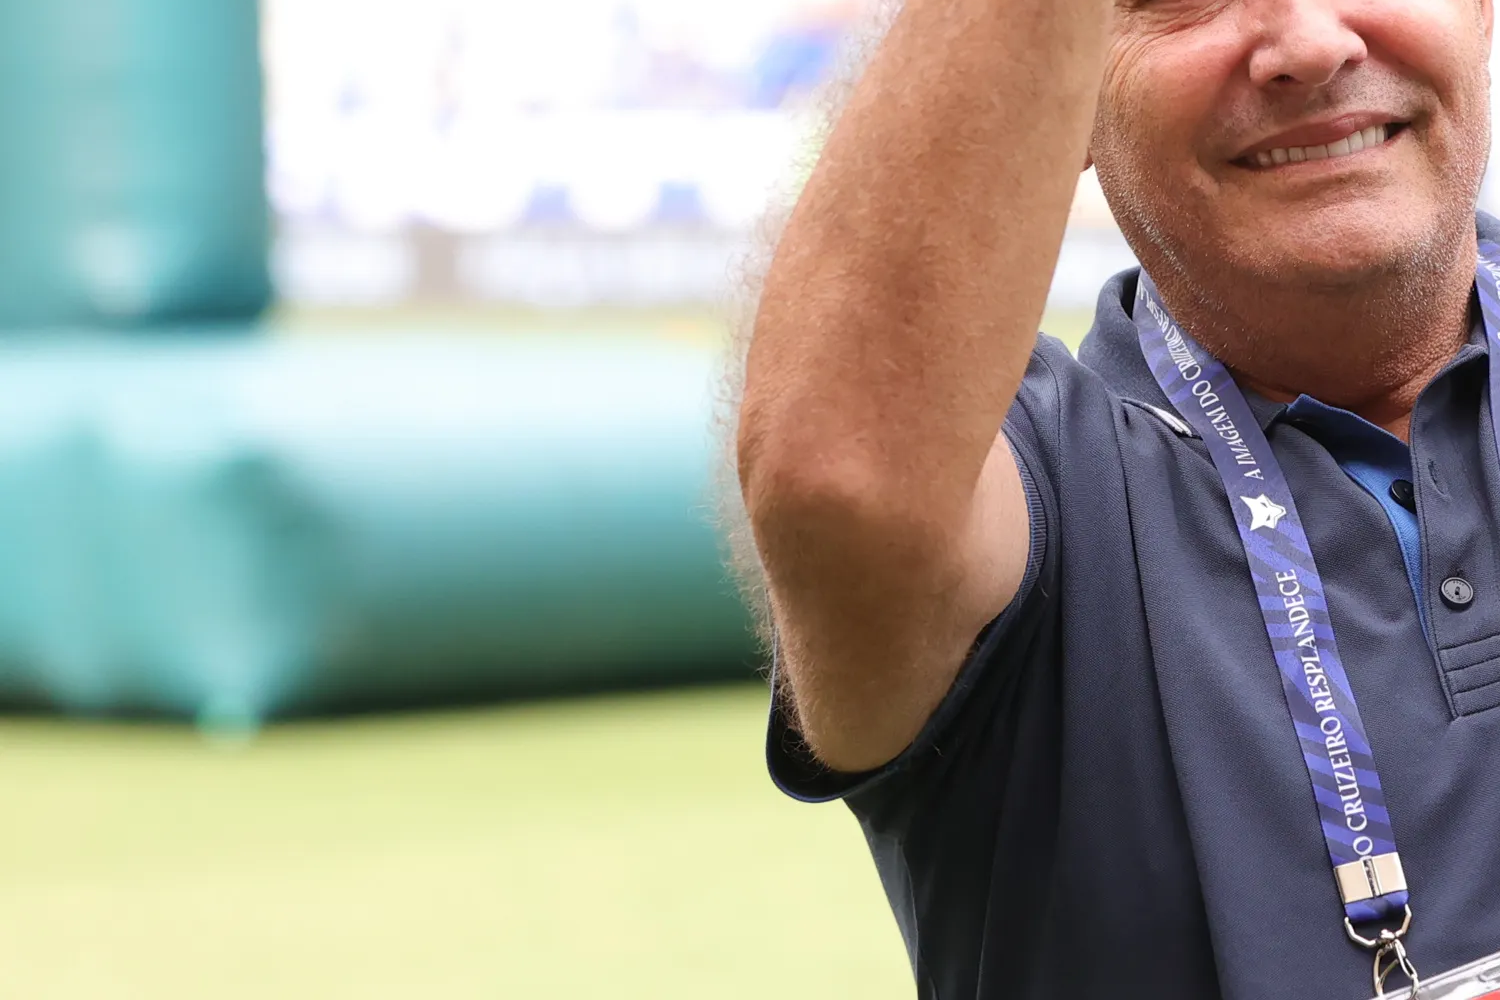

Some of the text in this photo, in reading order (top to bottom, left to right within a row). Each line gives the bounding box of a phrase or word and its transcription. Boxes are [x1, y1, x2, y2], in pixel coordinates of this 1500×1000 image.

[1192, 380, 1219, 408] DO
[1205, 405, 1256, 466] IMAGEM
[1244, 468, 1264, 480] A
[1275, 569, 1373, 861] O CRUZEIRO RESPLANDECE
